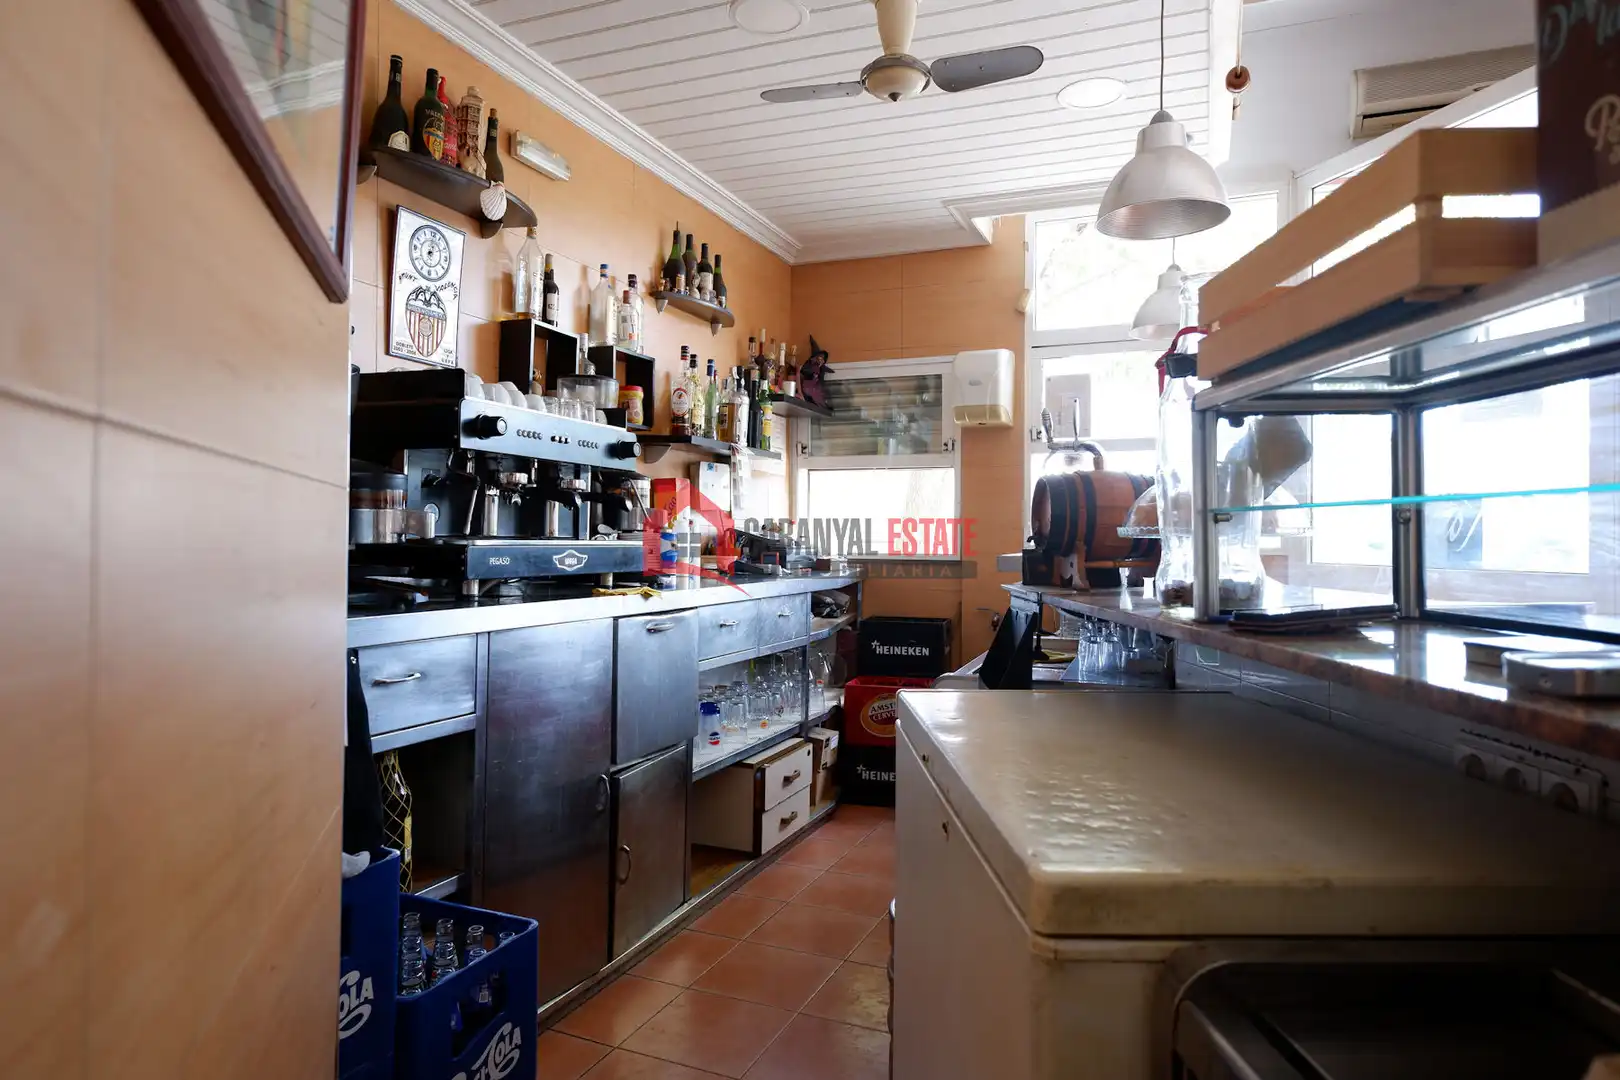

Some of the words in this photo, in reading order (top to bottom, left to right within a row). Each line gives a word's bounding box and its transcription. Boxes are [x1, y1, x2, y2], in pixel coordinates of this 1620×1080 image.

[489, 556, 510, 565] PEGASO
[876, 645, 930, 656] HEINEKEN
[870, 702, 896, 714] AMST
